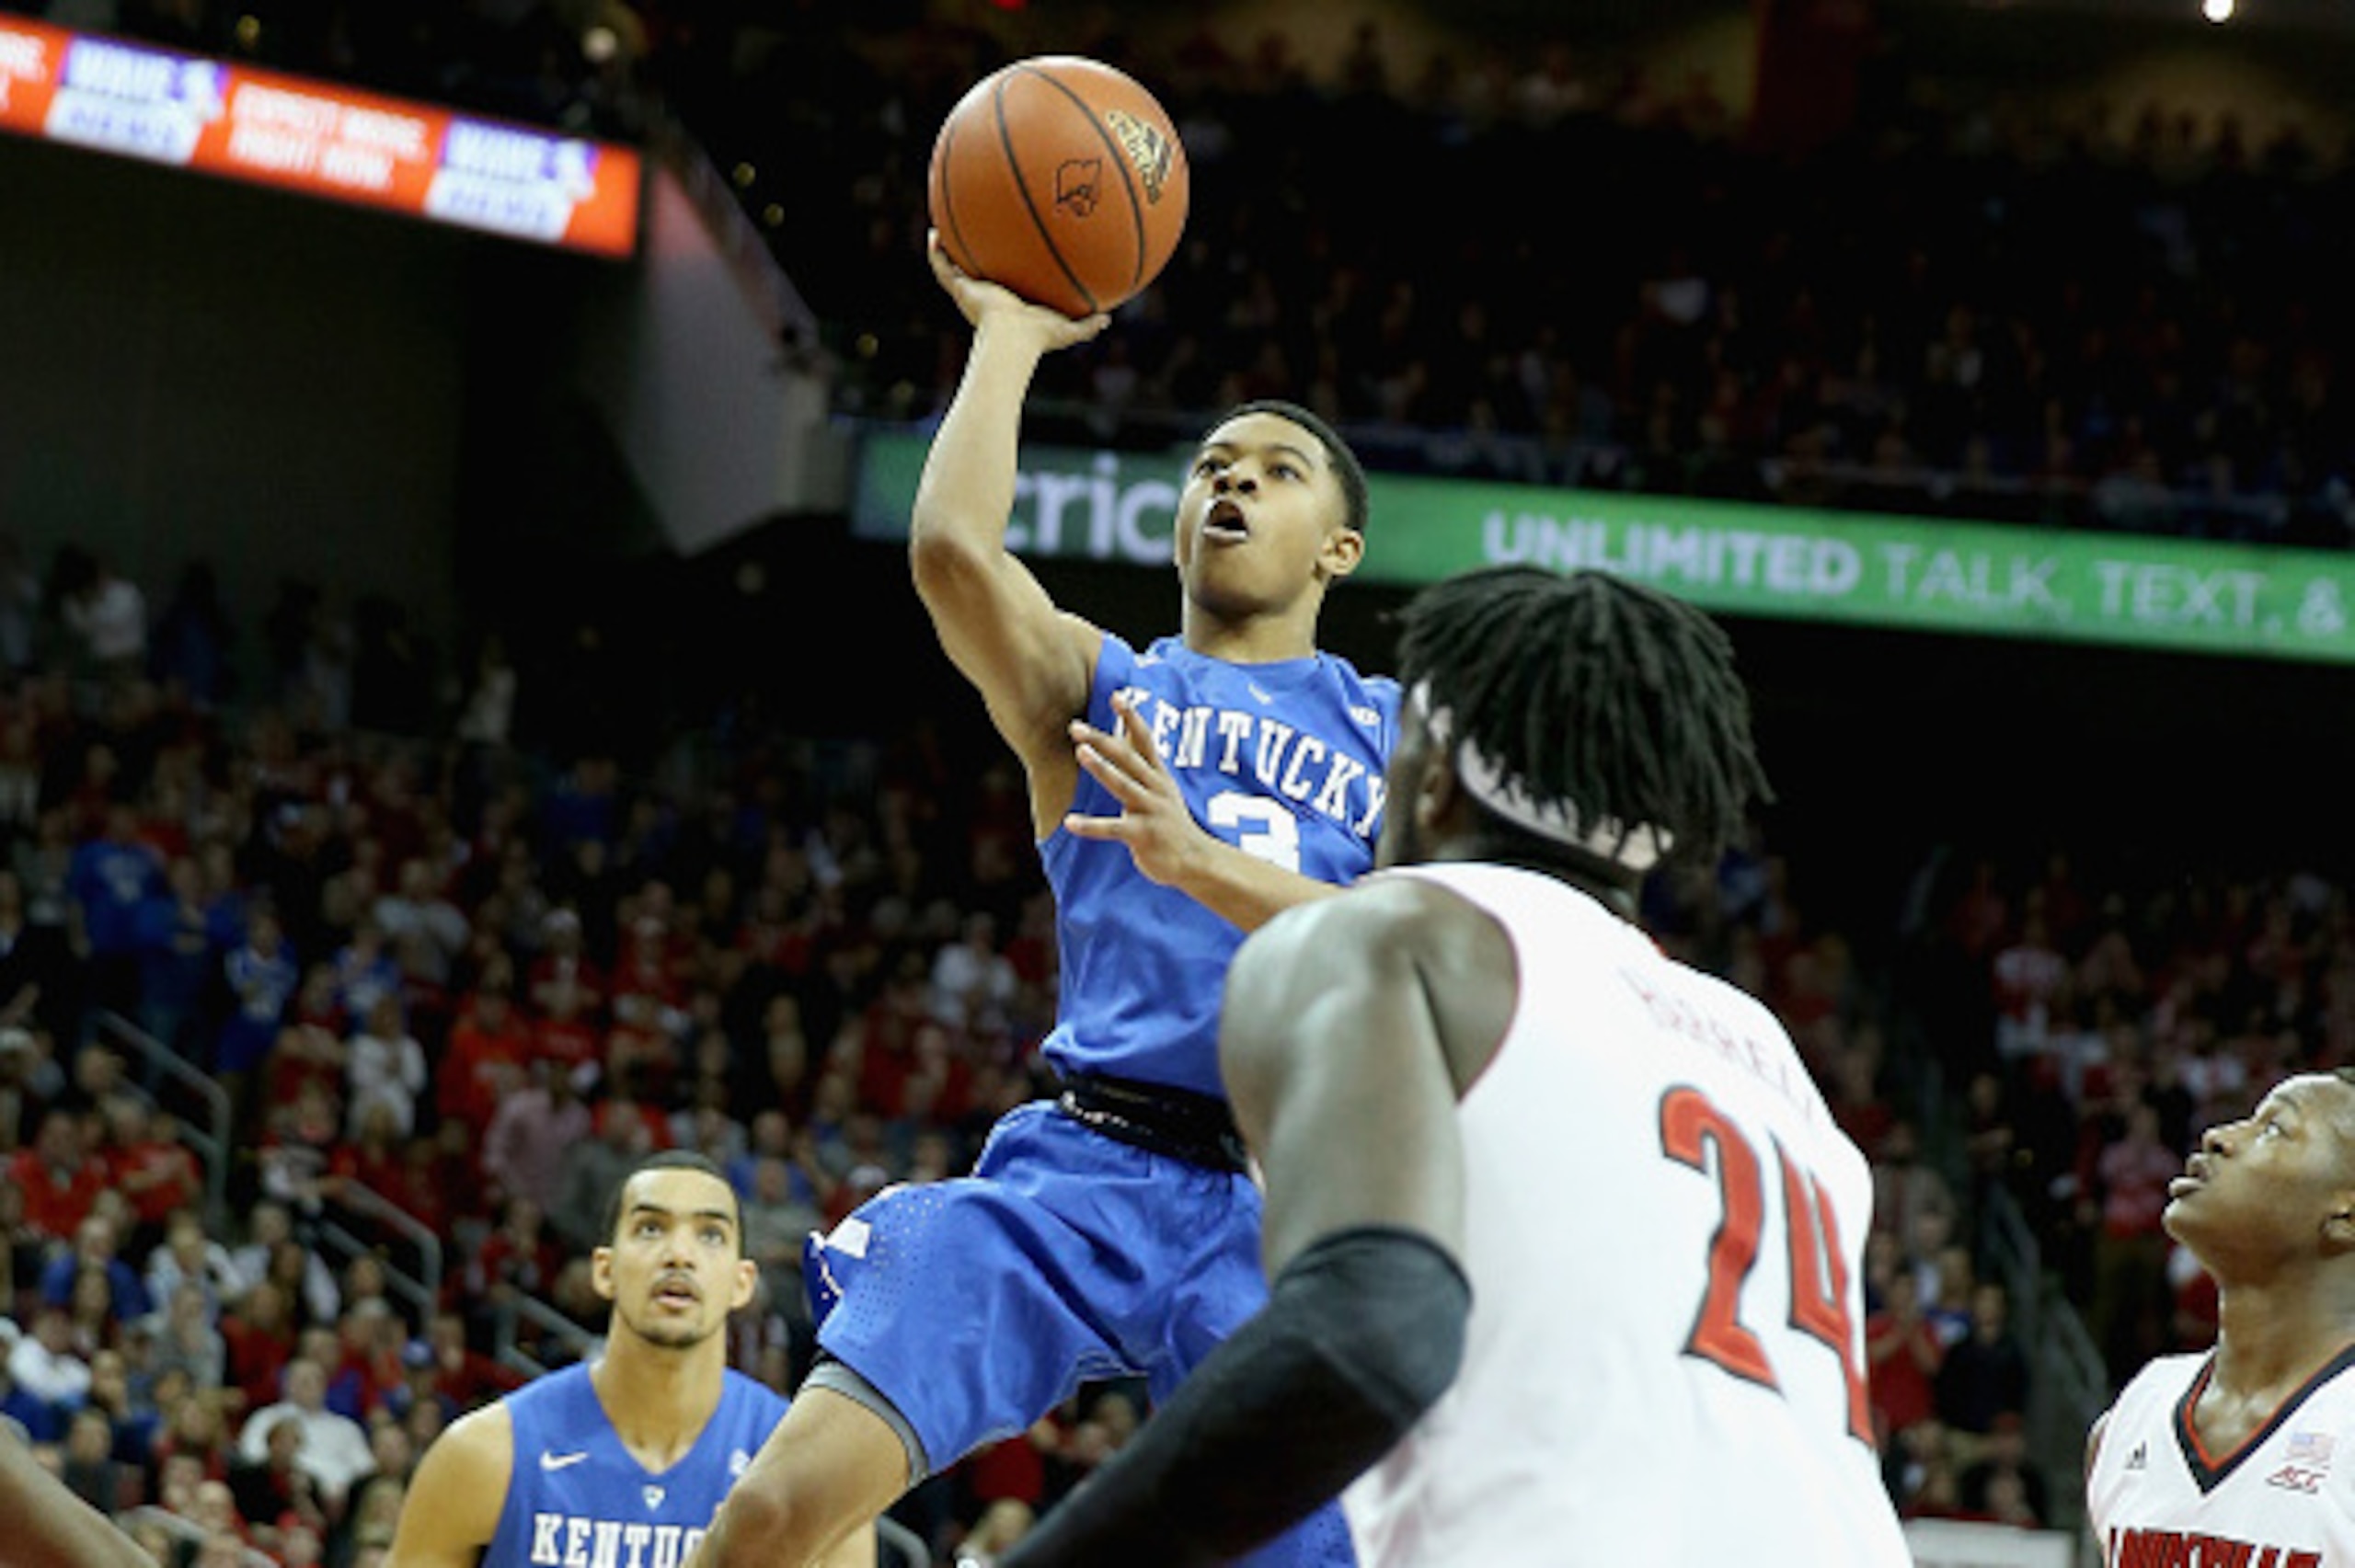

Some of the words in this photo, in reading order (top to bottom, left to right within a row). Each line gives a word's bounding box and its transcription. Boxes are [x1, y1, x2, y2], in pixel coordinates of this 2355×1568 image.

[1482, 509, 1862, 596] UNLIMITED
[1880, 543, 2074, 624] TALK,
[2091, 558, 2282, 638] TEXT,
[2297, 577, 2348, 634] &
[1658, 1082, 1875, 1448] 24
